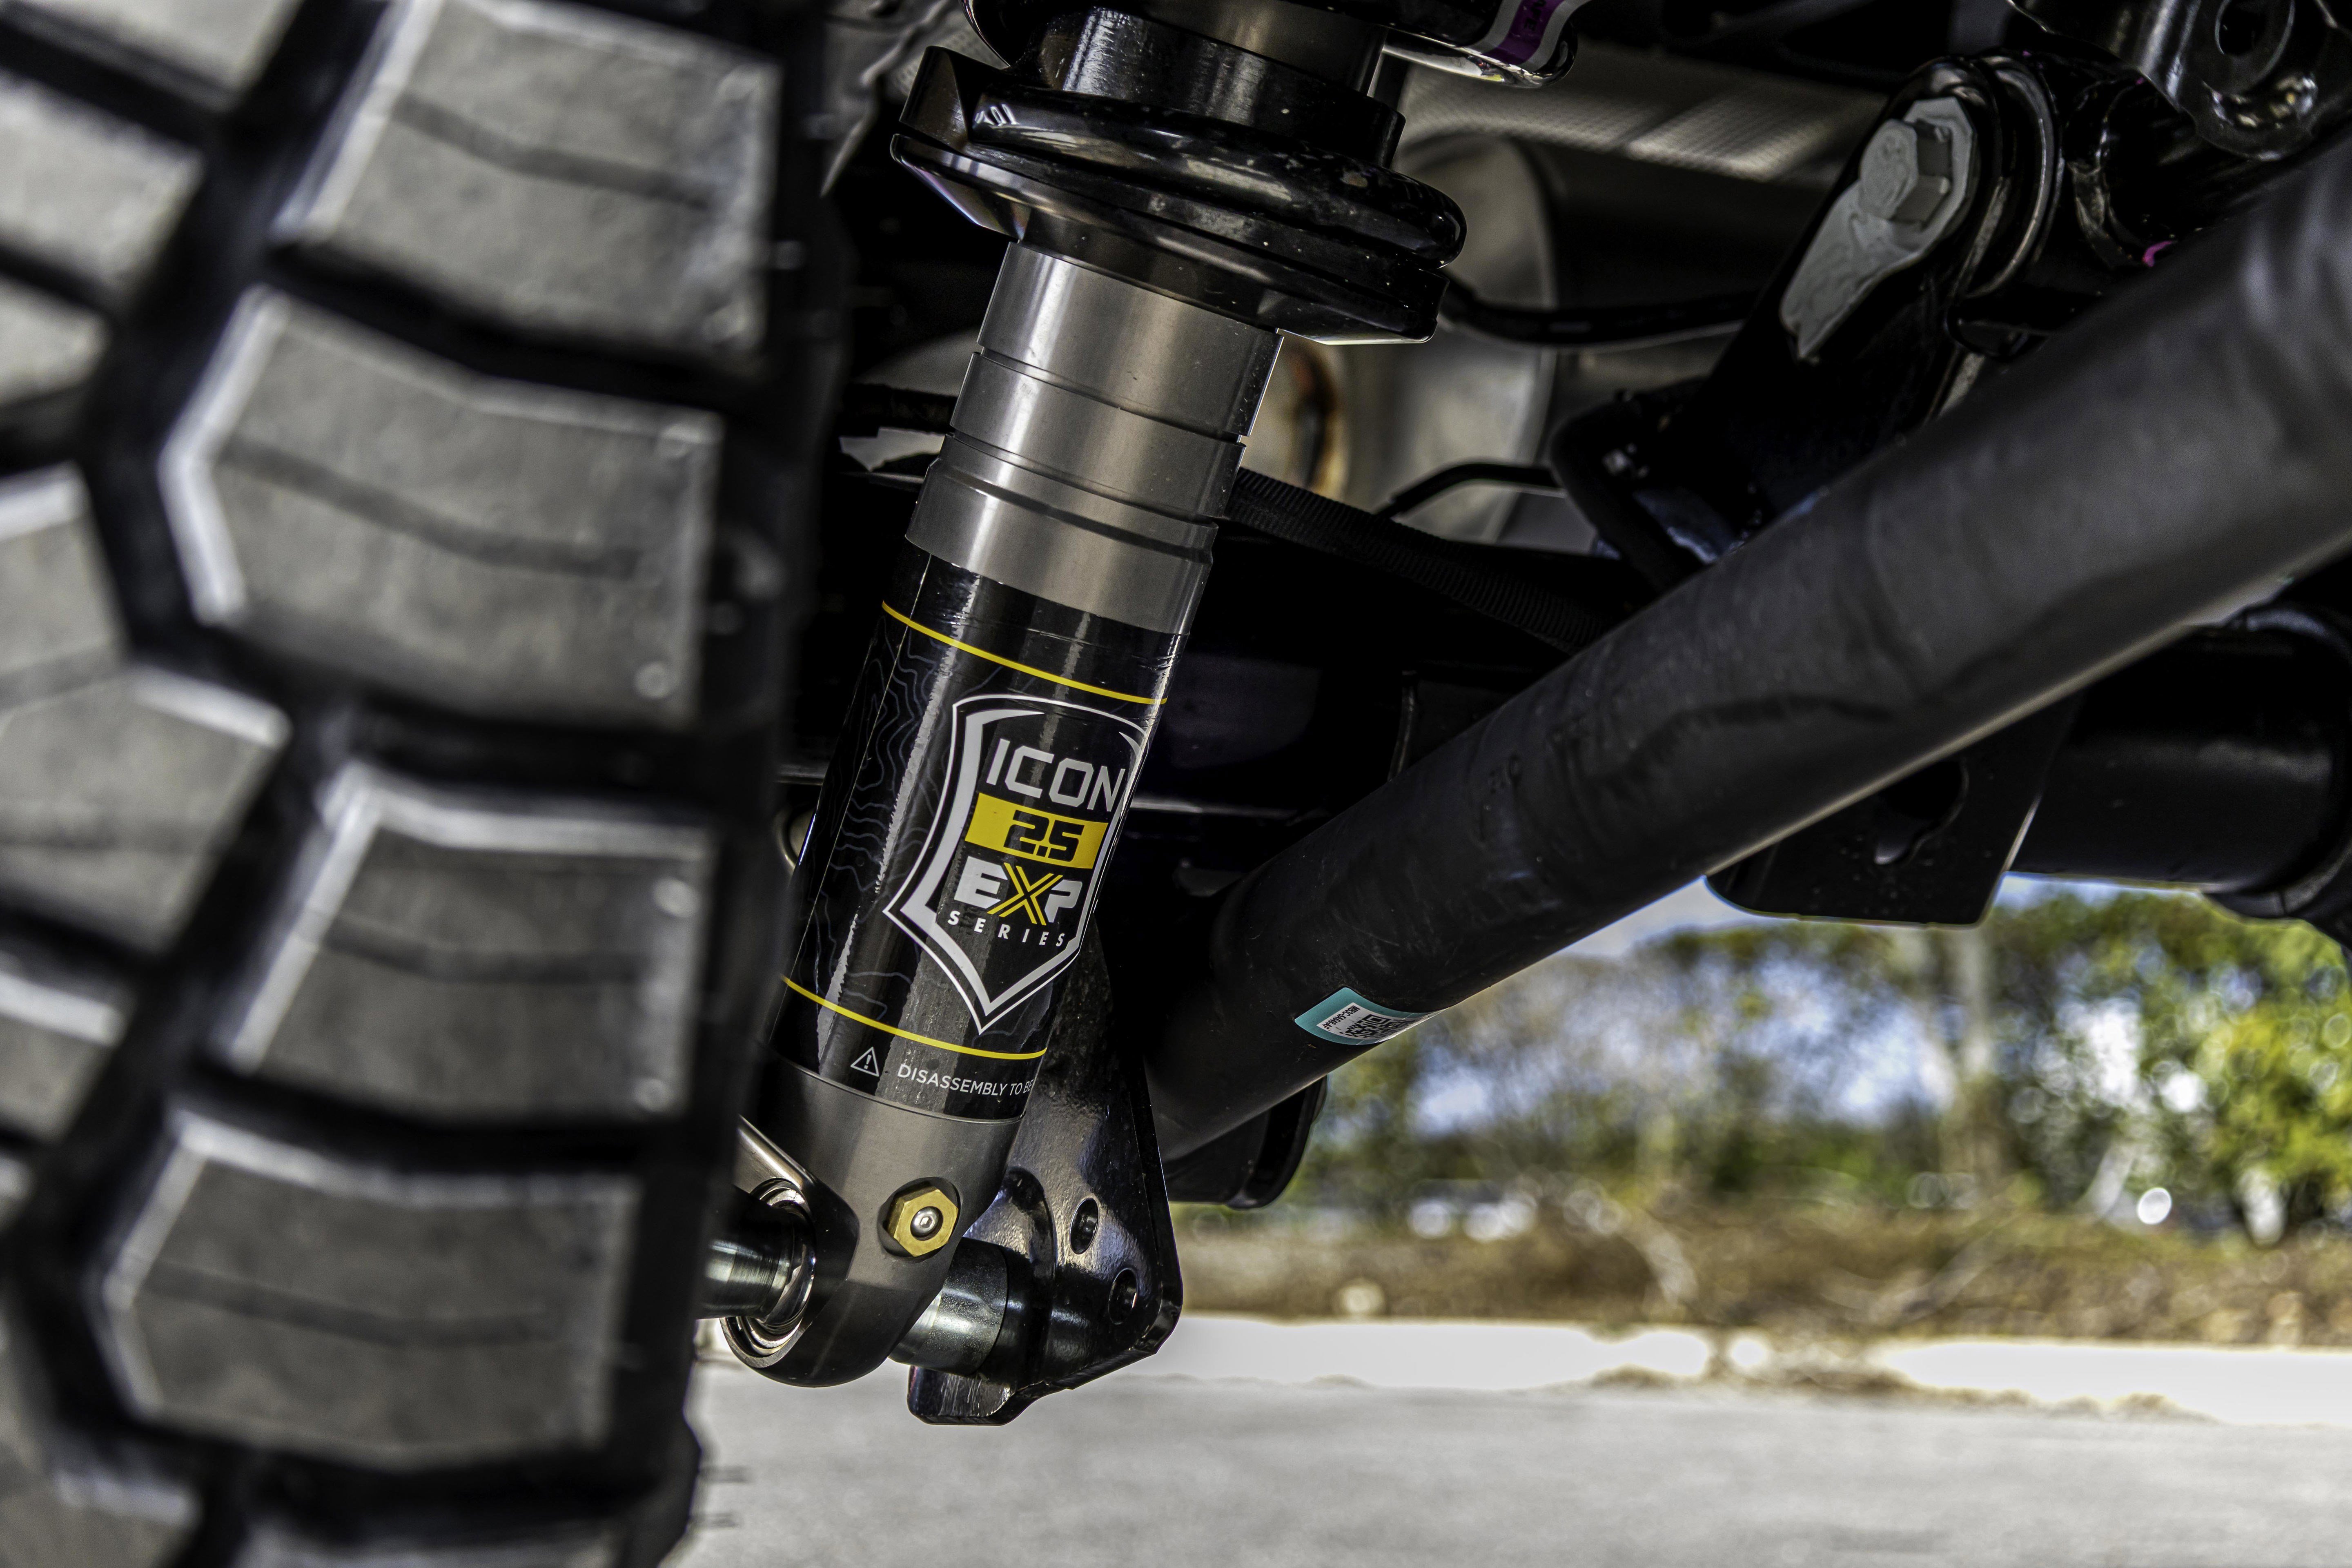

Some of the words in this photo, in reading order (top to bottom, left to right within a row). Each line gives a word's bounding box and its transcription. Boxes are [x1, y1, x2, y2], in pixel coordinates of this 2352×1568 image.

[986, 738, 1126, 812] ICON
[1004, 810, 1084, 862] 2.5
[954, 856, 1082, 926] EXP
[948, 911, 1063, 947] SERIES
[898, 1064, 1007, 1096] DISASSEMBLY
[1009, 1082, 1022, 1096] TO
